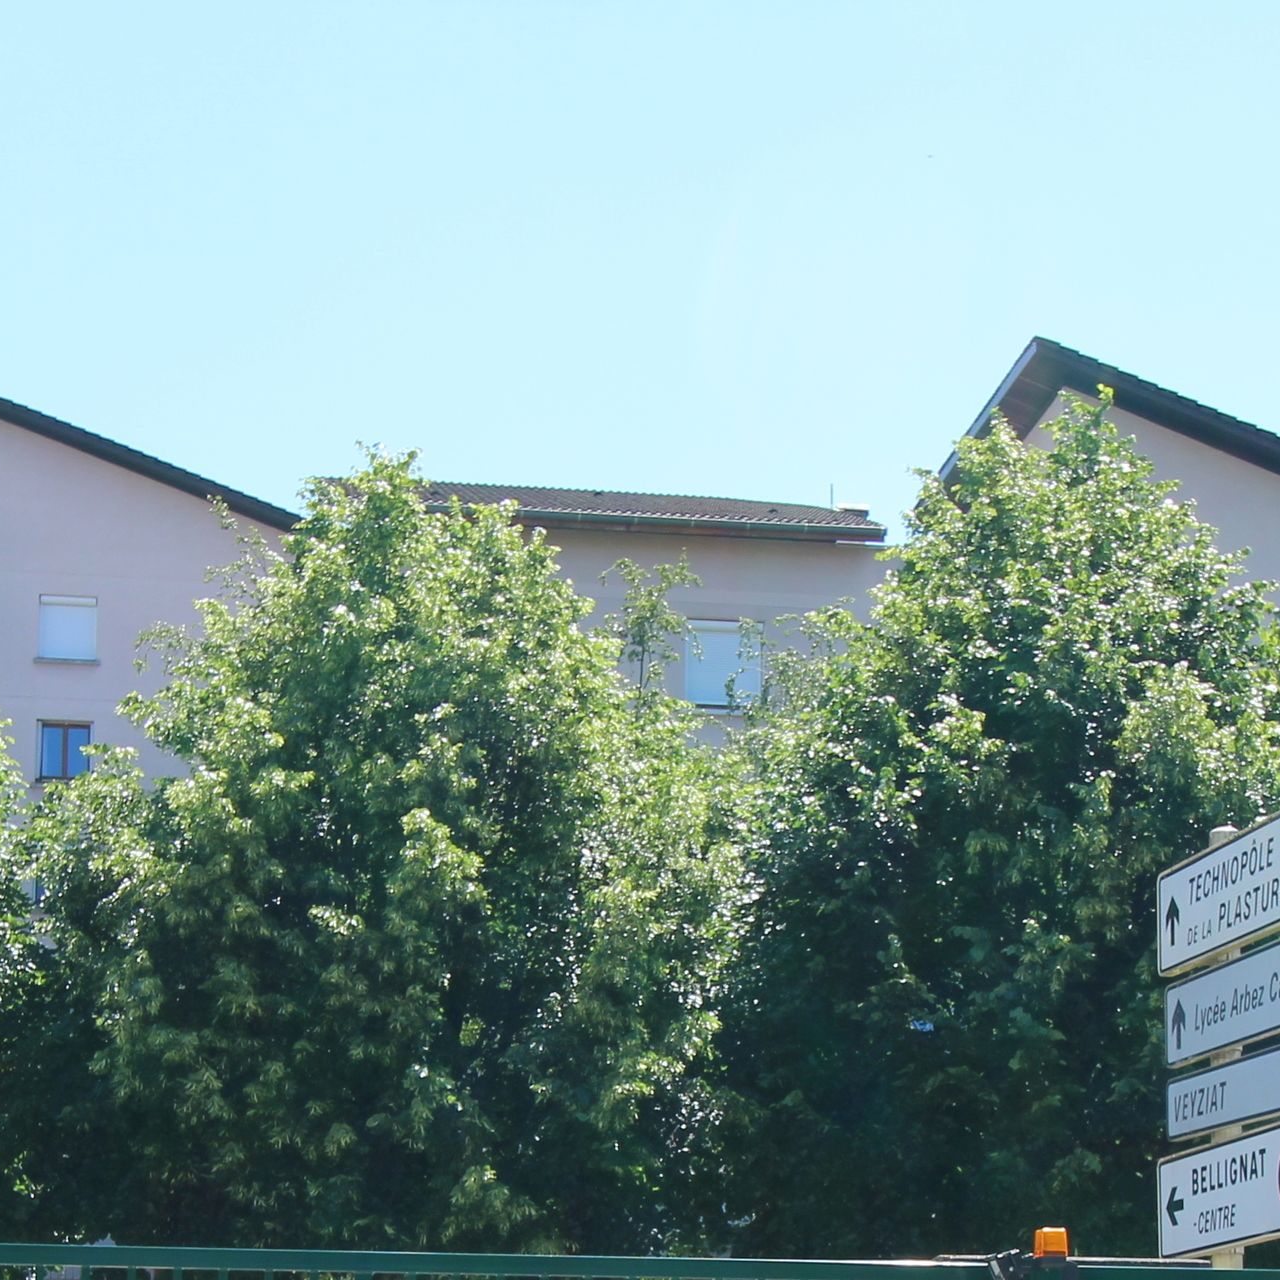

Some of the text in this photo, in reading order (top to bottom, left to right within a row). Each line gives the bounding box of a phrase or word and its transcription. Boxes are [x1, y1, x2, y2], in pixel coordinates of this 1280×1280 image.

[1188, 836, 1275, 906] TECHNOPÔLE
[1186, 924, 1200, 946] DE
[1201, 918, 1213, 940] LA
[1194, 996, 1227, 1032] Lycée
[1230, 980, 1265, 1018] Arbez
[1173, 1081, 1227, 1123] VEYZIAT
[1191, 1148, 1267, 1196] BELLIGNAT
